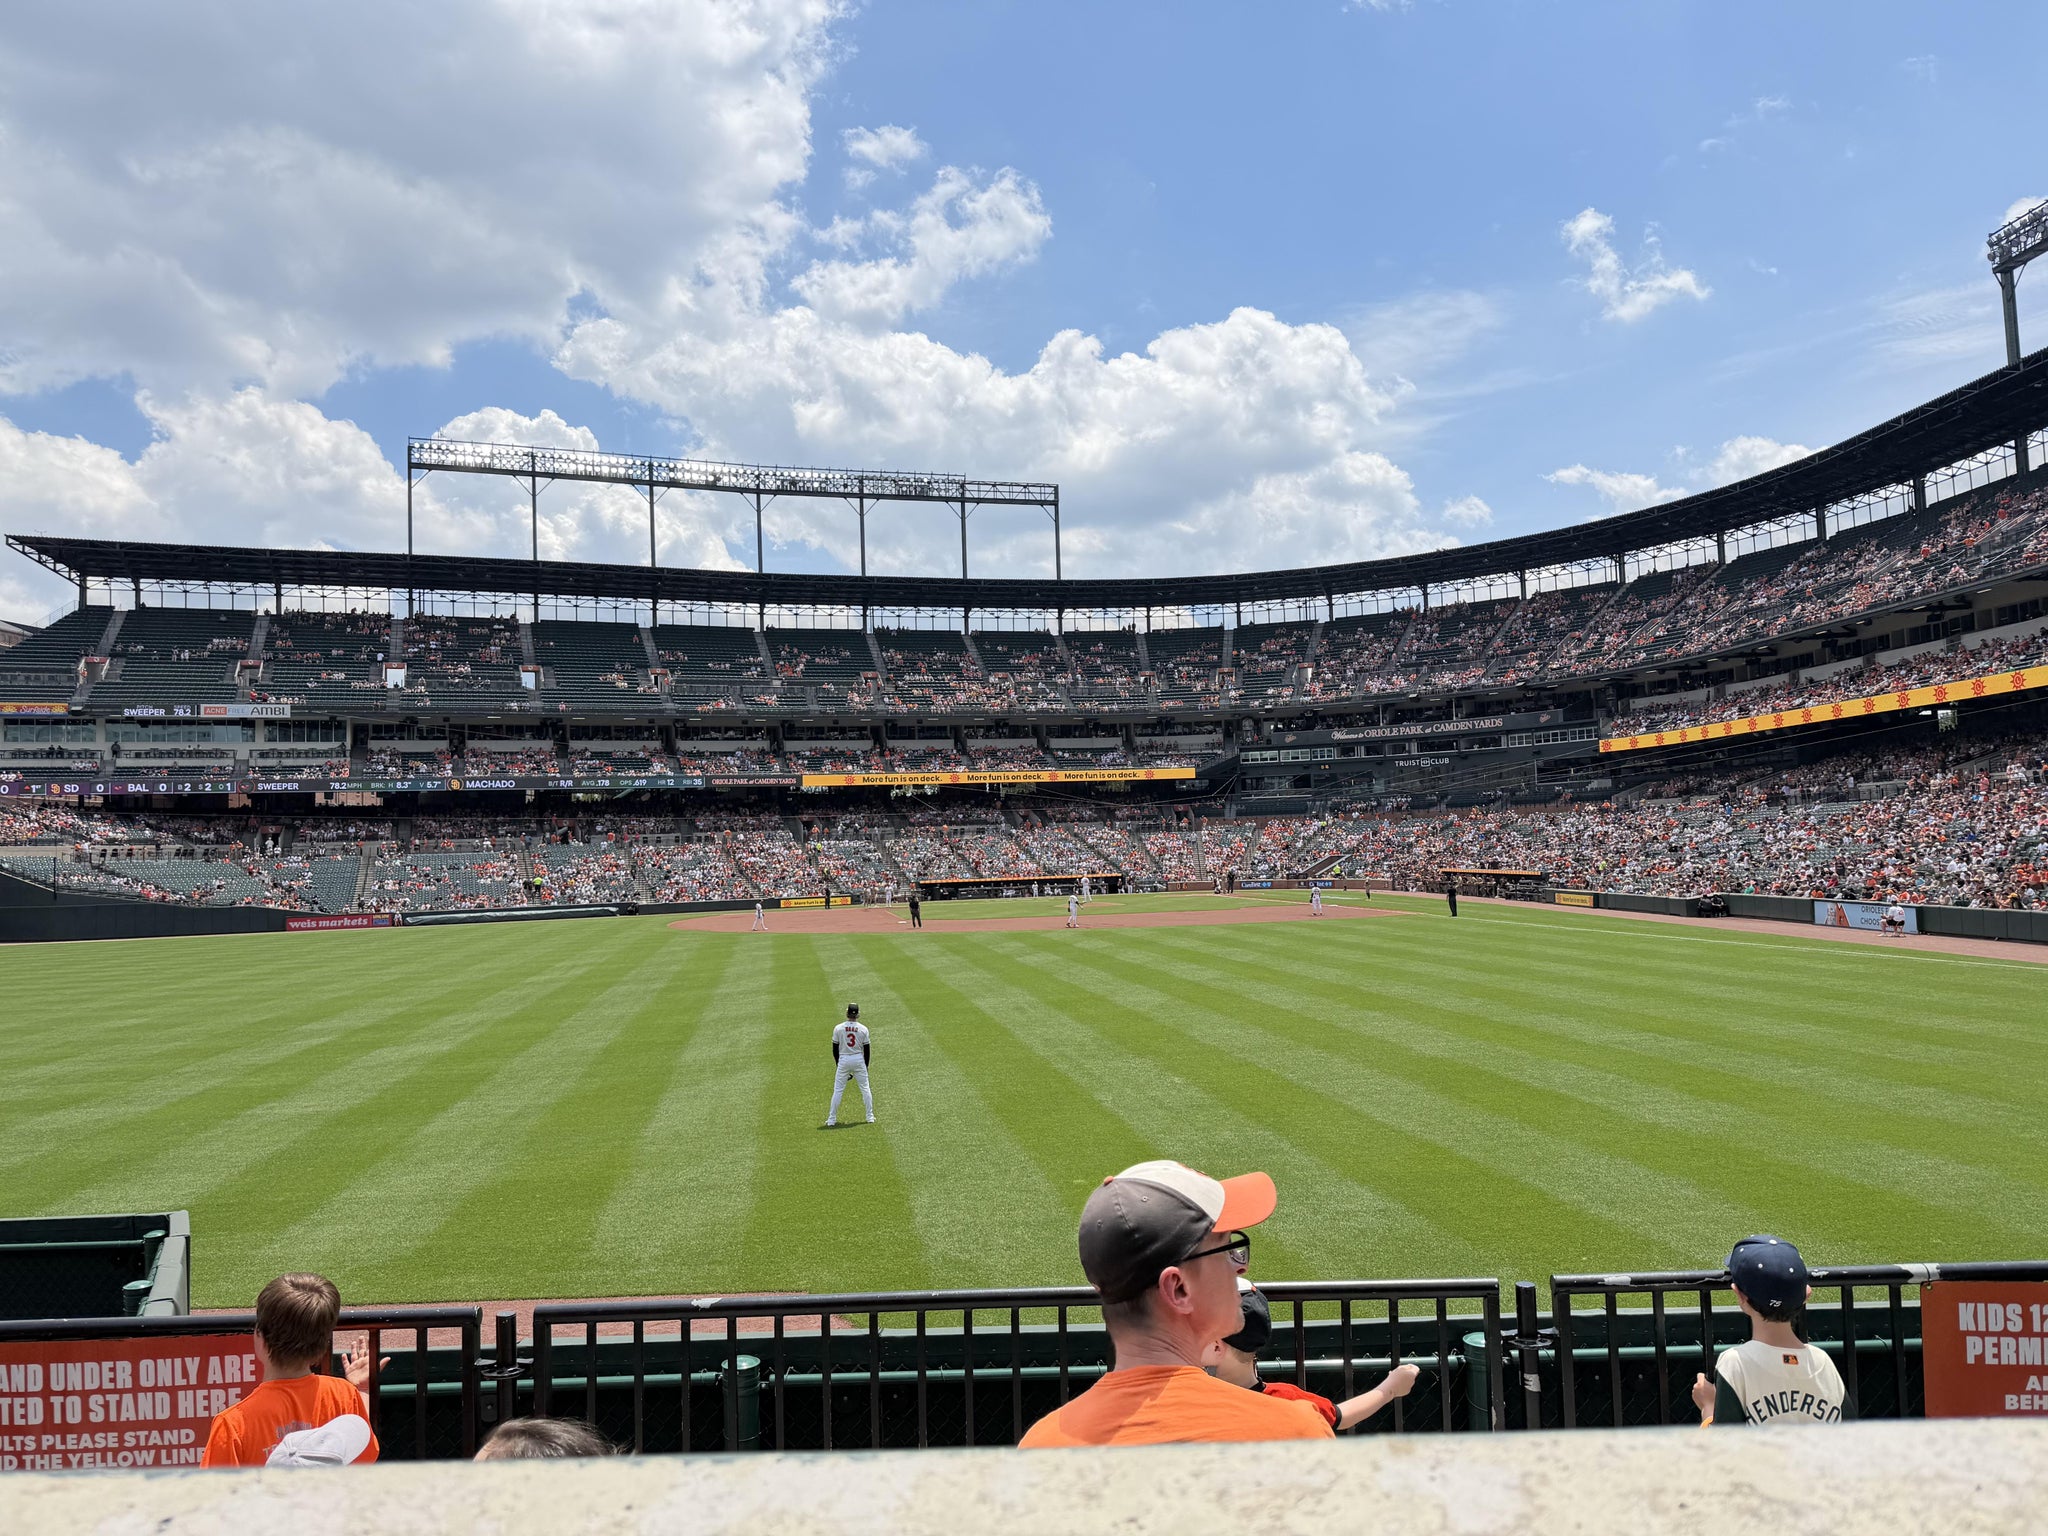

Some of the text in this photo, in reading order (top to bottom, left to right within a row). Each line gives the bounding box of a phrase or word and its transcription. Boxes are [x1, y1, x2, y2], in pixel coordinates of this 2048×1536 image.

[123, 708, 192, 716] SWEEPER 78.2
[1364, 728, 1399, 738] ORIOLE
[1399, 725, 1423, 735] PARK
[1432, 720, 1473, 732] CAMDEN
[1473, 718, 1503, 728] YARDS
[1395, 757, 1450, 767] TRUIST CLUB
[862, 775, 883, 783] More
[884, 775, 898, 783] fun
[920, 774, 943, 782] deck.
[967, 774, 988, 782] More
[988, 773, 1002, 781] fun
[1003, 773, 1010, 781] is
[1064, 772, 1084, 780] More
[64, 783, 79, 793] SD
[96, 783, 104, 793] 0
[127, 783, 167, 792] BAL 0
[184, 782, 191, 792] 2
[205, 782, 212, 792] 2
[226, 782, 231, 791] 1
[257, 782, 299, 791] SWEEPER
[330, 782, 347, 790] 78.2
[466, 780, 516, 788] MACHADO
[560, 780, 573, 788] R/R
[596, 779, 610, 787] .178
[667, 778, 675, 786] 12
[693, 778, 702, 786] 35
[1861, 905, 1884, 915] ORIOLES
[289, 919, 317, 929] weis
[319, 917, 368, 927] markets
[1861, 917, 1880, 926] CHOOS
[847, 1033, 856, 1048] 3
[1958, 1302, 2023, 1333] KIDS
[0, 1354, 257, 1393] AND UNDER ONLY ARE
[50, 1395, 82, 1424] TO
[88, 1391, 171, 1423] STAND
[0, 1428, 195, 1452] LTS PLEASE STAND
[0, 1447, 205, 1471] D THE YELLOW LINE
